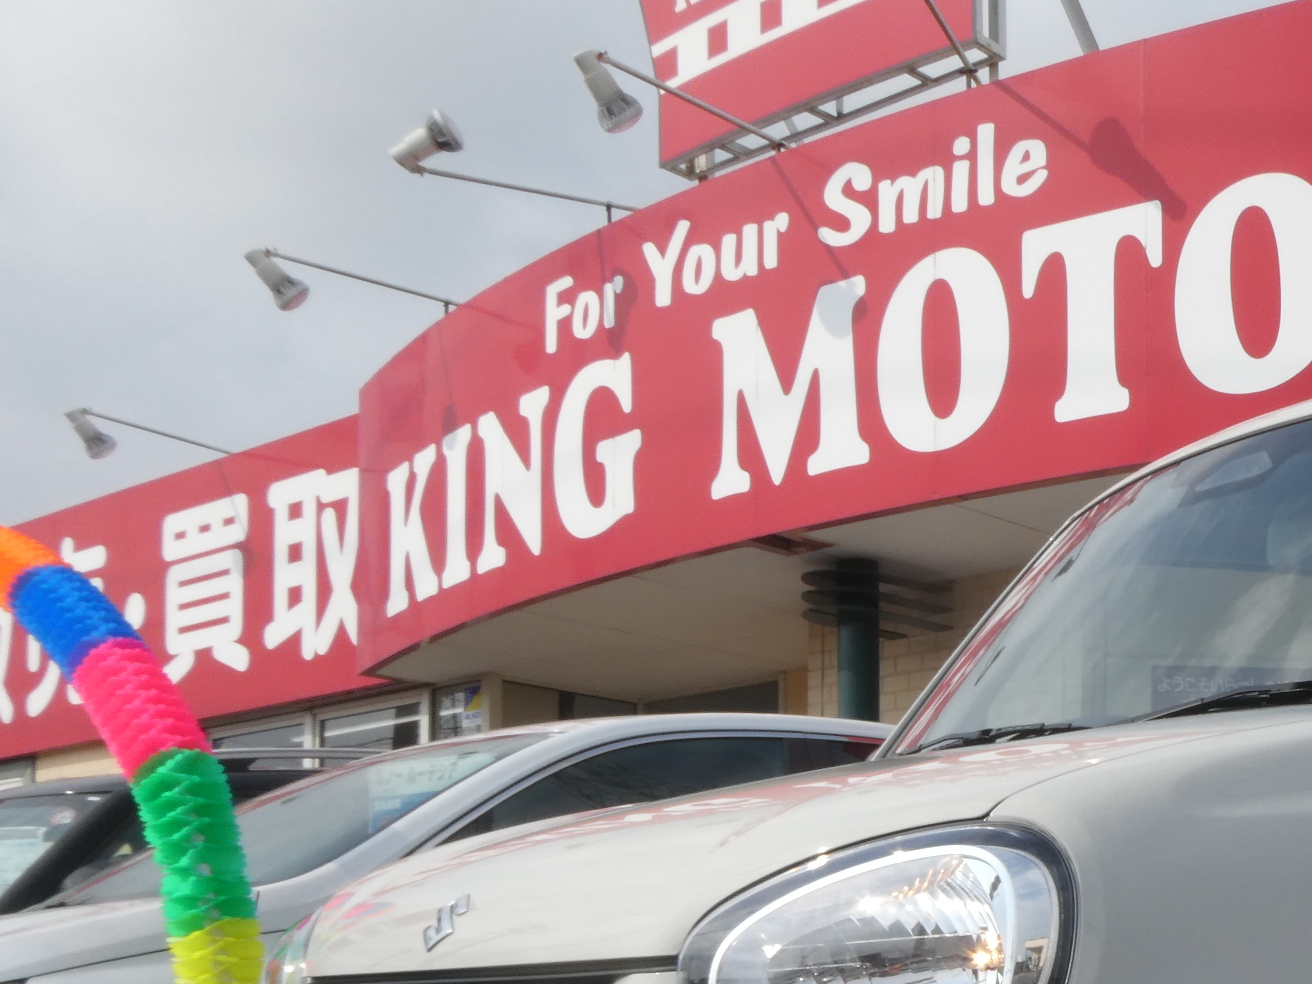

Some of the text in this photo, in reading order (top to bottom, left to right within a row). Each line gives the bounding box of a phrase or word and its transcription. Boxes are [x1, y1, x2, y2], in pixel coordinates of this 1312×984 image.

[544, 123, 1048, 354] For Your Smile
[386, 352, 642, 617] KING
